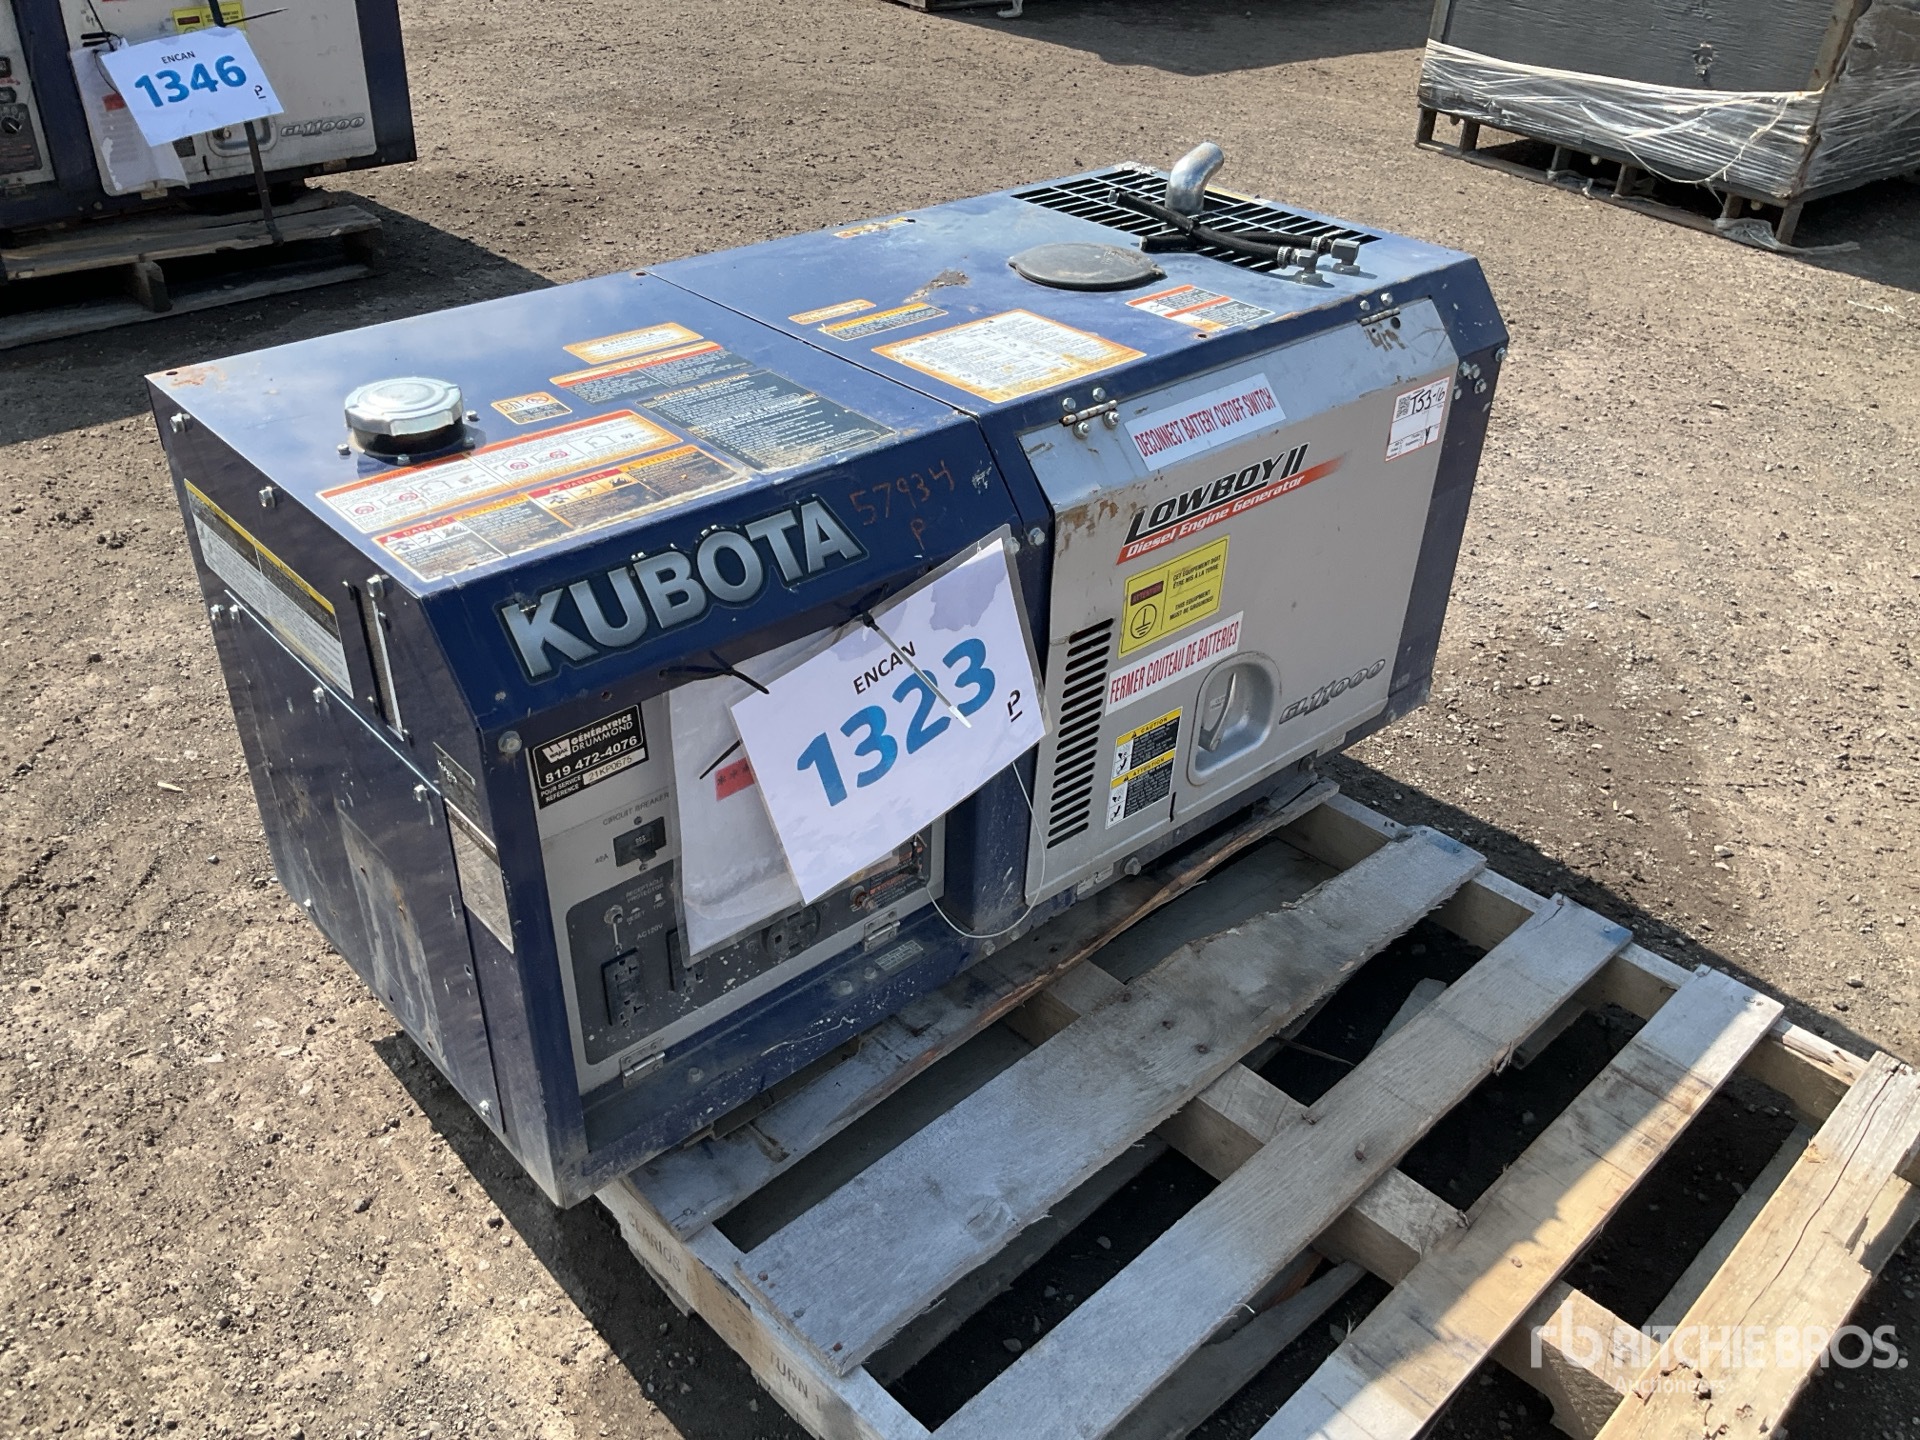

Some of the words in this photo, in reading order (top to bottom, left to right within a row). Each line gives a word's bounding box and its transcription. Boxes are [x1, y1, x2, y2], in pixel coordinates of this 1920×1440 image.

[135, 55, 247, 107] 1346
[162, 51, 195, 64] ENCAN
[1133, 420, 1183, 457] DECONNECT
[1179, 407, 1218, 440] BATTERY
[1213, 399, 1246, 428] CUTOFF
[1241, 386, 1277, 417] SWITCH
[563, 473, 606, 489] DANGER
[849, 459, 954, 526] 57934
[1123, 452, 1285, 546] LOWBOY
[1126, 528, 1177, 558] Diesel
[1178, 506, 1229, 538] Engine
[1231, 475, 1305, 512] Generator
[501, 500, 863, 677] KUBOTA
[853, 641, 917, 694] ENCAN
[1109, 666, 1145, 704] FERMER
[1146, 652, 1184, 686] COUTEAU
[1185, 645, 1197, 668] DE
[1196, 621, 1240, 662] BATTERIES
[571, 713, 632, 745] GÉNÉRATRICE
[572, 721, 633, 753] DRUMMOND
[797, 638, 996, 807] 1323
[1140, 717, 1168, 733] CAUTION
[545, 765, 571, 783] 819
[574, 735, 637, 771] 472-4076
[588, 755, 632, 781] 21KP0675
[541, 785, 557, 797] POUR
[558, 775, 581, 790] SERVICE
[603, 808, 633, 826] CIRCUIT
[634, 792, 669, 813] BREAKER
